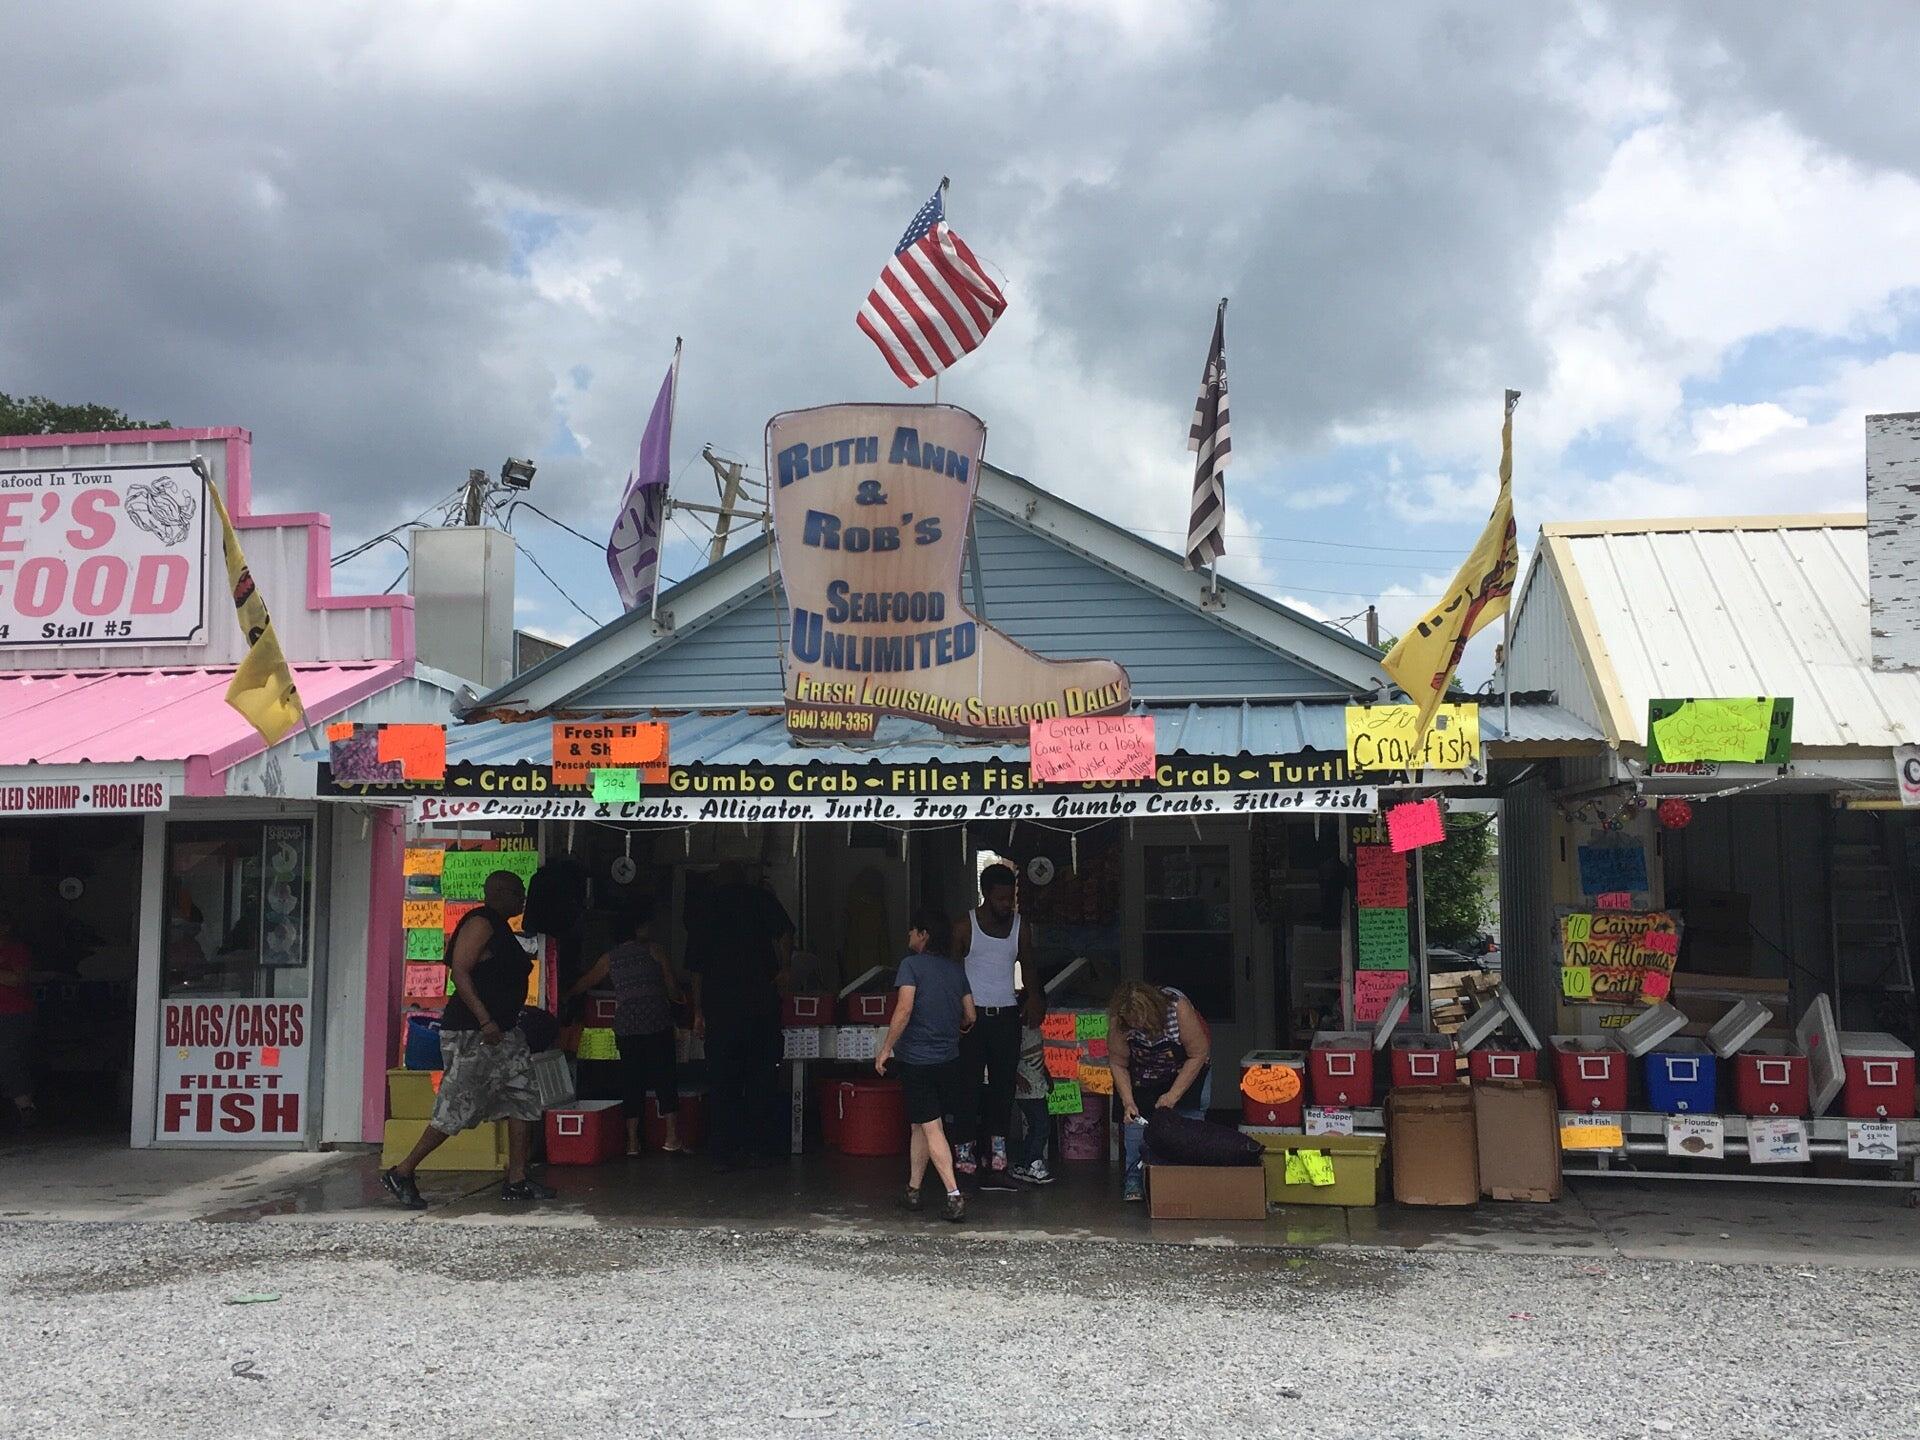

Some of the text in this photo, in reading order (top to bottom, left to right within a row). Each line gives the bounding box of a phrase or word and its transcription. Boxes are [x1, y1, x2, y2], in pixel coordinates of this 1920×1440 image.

[0, 472, 113, 488] afood In Town
[855, 479, 888, 506] &
[41, 621, 94, 639] Stall
[104, 620, 132, 637] #5
[791, 607, 977, 673] UNLIMITED
[787, 708, 874, 732] (504) 340-3351
[1049, 718, 1135, 738] Great Deals
[564, 726, 614, 739] Fresh
[569, 743, 582, 756] &
[1034, 735, 1145, 757] Come take a look
[1354, 727, 1473, 767] Crawfish
[554, 760, 600, 770] Pescados
[1078, 756, 1106, 779] Oyster
[480, 770, 547, 792] Crab
[670, 770, 775, 792] Gumbo
[788, 770, 859, 792] Crab
[892, 768, 971, 792] Fillet
[1156, 764, 1230, 788] Crab
[0, 782, 163, 810] LED SHRIMP FROG LEGS
[483, 799, 586, 819] Crawfish
[595, 801, 612, 818] &
[913, 798, 967, 819] Frog
[1051, 795, 1137, 818] Gumbo
[1233, 789, 1305, 811] Fillet
[1314, 787, 1369, 810] Fish
[497, 837, 536, 851] PECIAL
[165, 1003, 304, 1048] BAGS/CASES
[214, 1051, 253, 1070] OF
[180, 1074, 283, 1089] FILLET
[163, 1093, 299, 1133] FISH
[1307, 1110, 1352, 1121] Red Snapper
[1578, 1117, 1611, 1127] Red Fish
[1684, 1118, 1719, 1127] Flounder
[1861, 1124, 1893, 1132] Croaker
